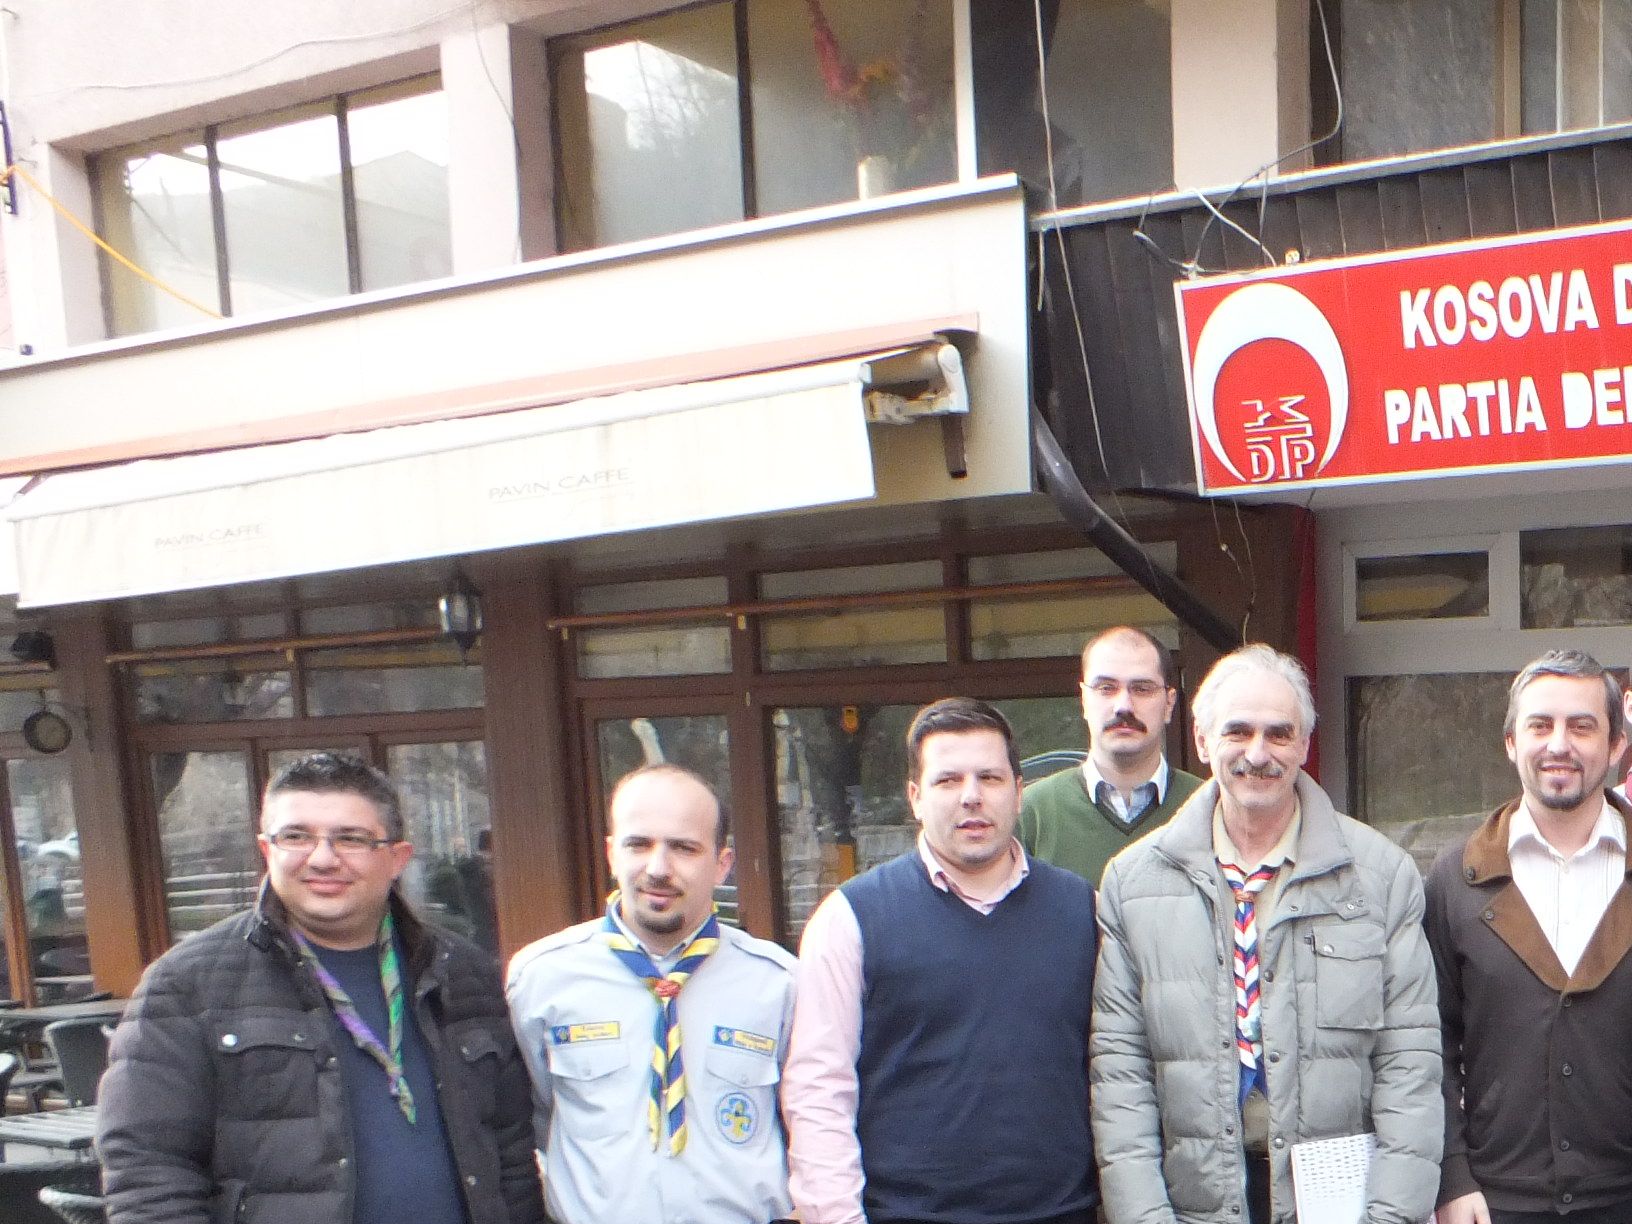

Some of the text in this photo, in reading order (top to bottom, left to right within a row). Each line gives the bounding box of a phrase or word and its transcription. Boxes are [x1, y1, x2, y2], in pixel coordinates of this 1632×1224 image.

[1400, 268, 1600, 350] KOSOVA
[1384, 375, 1548, 445] PARTIA
[558, 467, 631, 489] CAFFE
